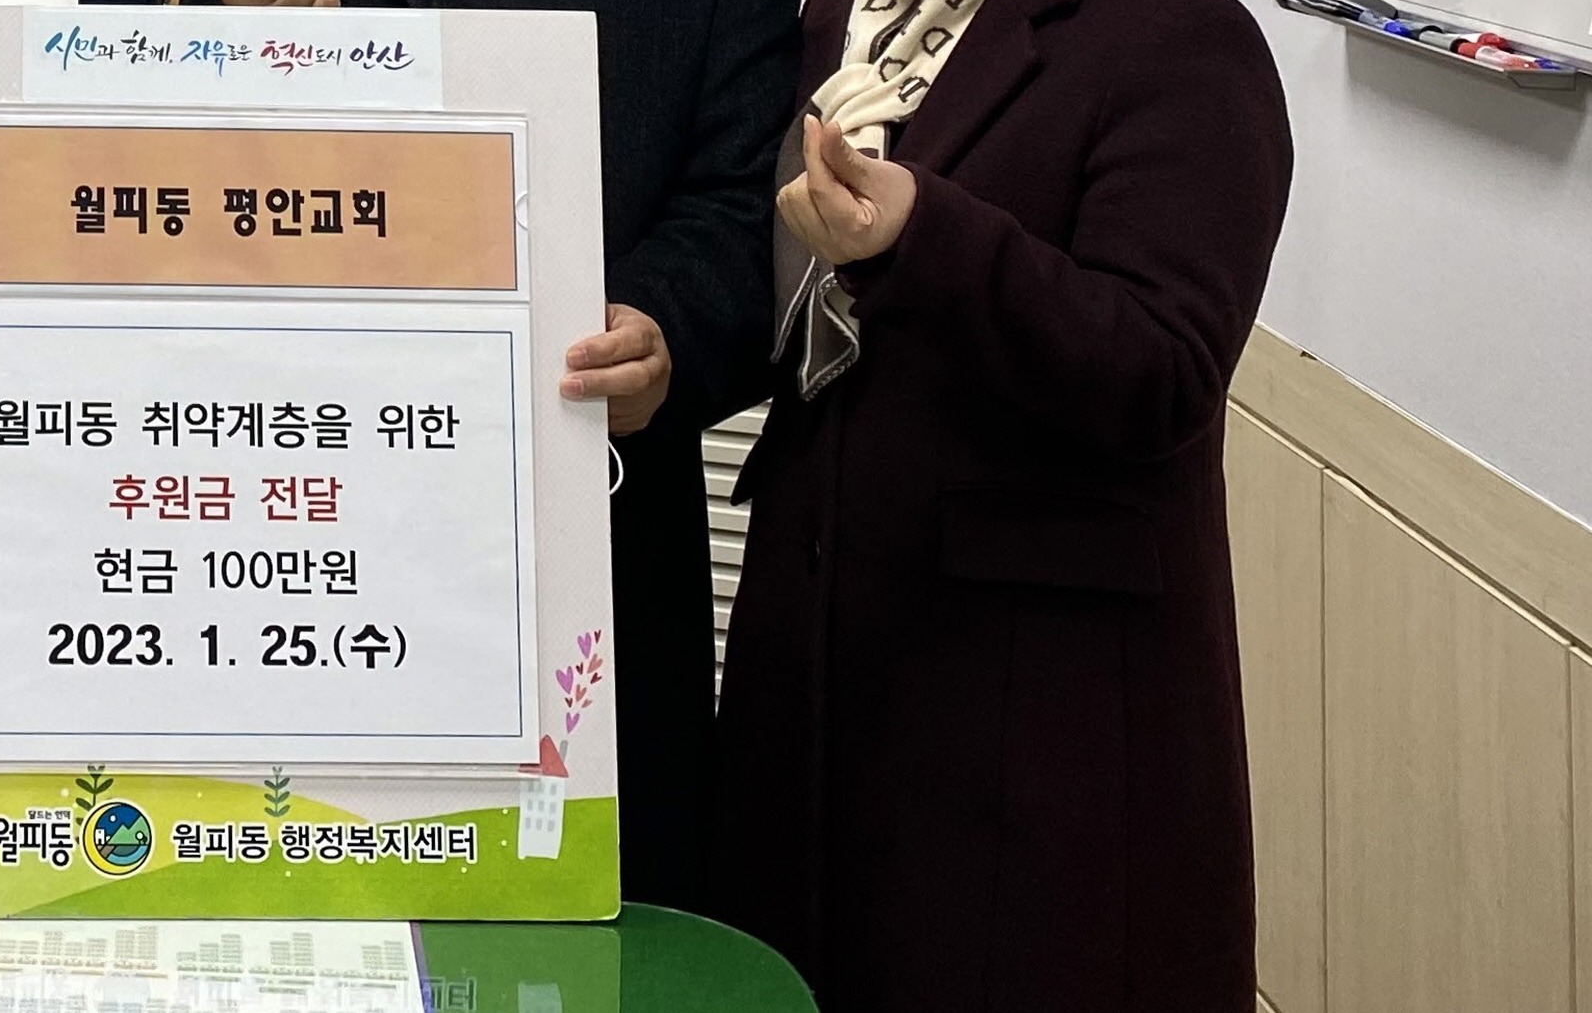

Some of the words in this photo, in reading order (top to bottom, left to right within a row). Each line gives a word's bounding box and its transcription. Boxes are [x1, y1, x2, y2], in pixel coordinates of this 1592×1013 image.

[45, 25, 119, 70] 시민과
[180, 39, 252, 77] 자유로운
[260, 40, 340, 75] 혁신도시
[349, 40, 416, 70] 안산
[70, 184, 192, 236] 월피동
[223, 187, 387, 238] 평안교회
[142, 401, 352, 449] 취약계층을
[376, 403, 460, 450] 위한
[109, 474, 236, 521] 후원금
[260, 476, 343, 522] 전달
[94, 548, 178, 594] 현금
[202, 549, 358, 595] 100만원
[48, 623, 174, 666] 2023.
[200, 624, 236, 666] 1.
[260, 623, 407, 668] 25.(수)
[172, 823, 269, 860] 월피동
[282, 824, 477, 861] 행정복지센터
